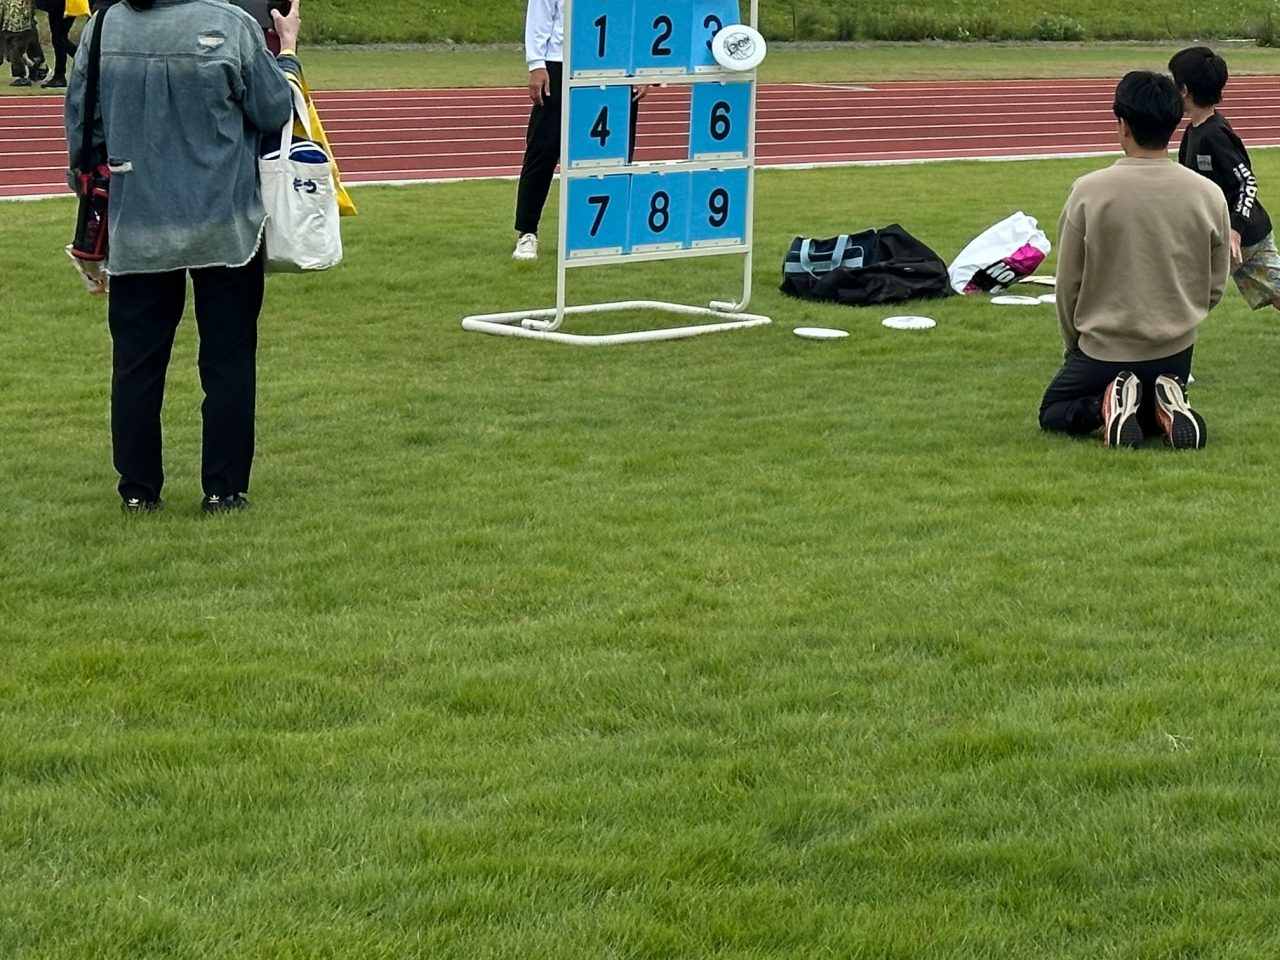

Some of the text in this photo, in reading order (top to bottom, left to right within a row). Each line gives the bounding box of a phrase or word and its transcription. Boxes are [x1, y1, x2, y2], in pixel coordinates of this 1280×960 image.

[594, 15, 608, 58] 1
[652, 16, 673, 56] 2
[589, 101, 731, 147] 4 6
[588, 188, 729, 237] 7 8 9
